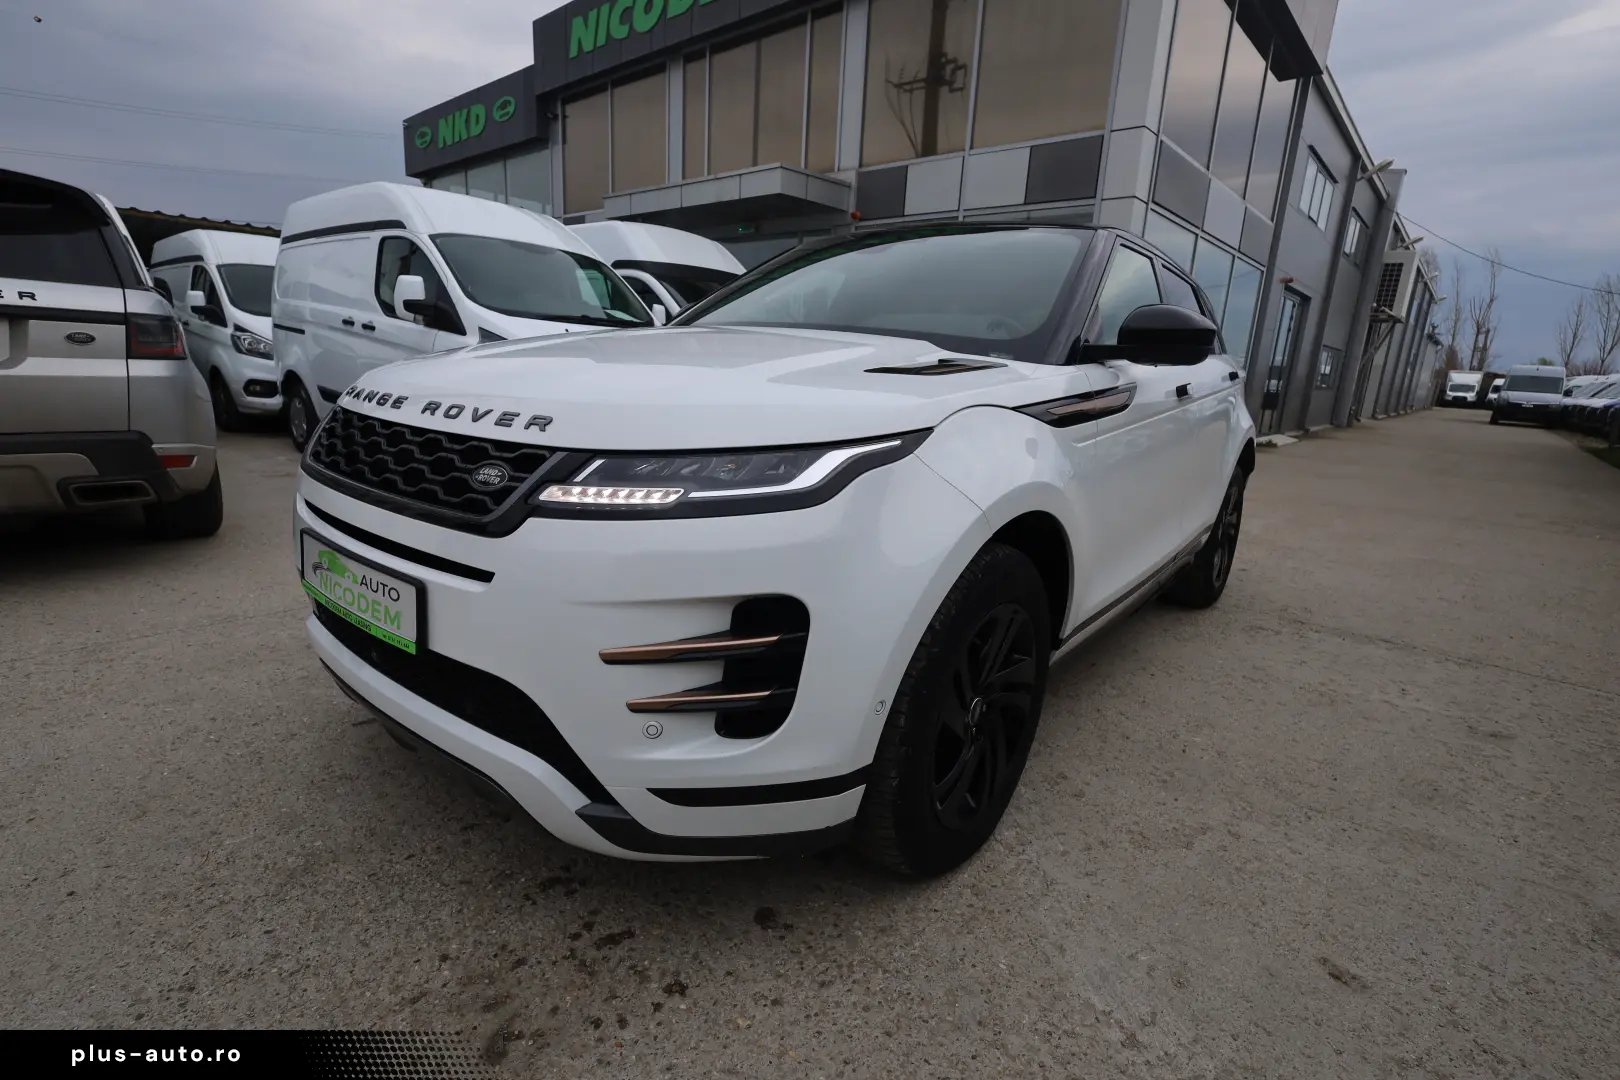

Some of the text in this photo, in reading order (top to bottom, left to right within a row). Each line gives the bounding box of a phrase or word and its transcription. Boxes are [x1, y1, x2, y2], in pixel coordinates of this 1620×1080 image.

[569, 0, 715, 59] NICO
[438, 104, 486, 149] NKD
[346, 385, 554, 432] RANGE ROVER
[476, 474, 501, 485] ROVER
[479, 467, 499, 476] LAND
[319, 571, 402, 630] NICODEM
[359, 574, 401, 602] AUTO
